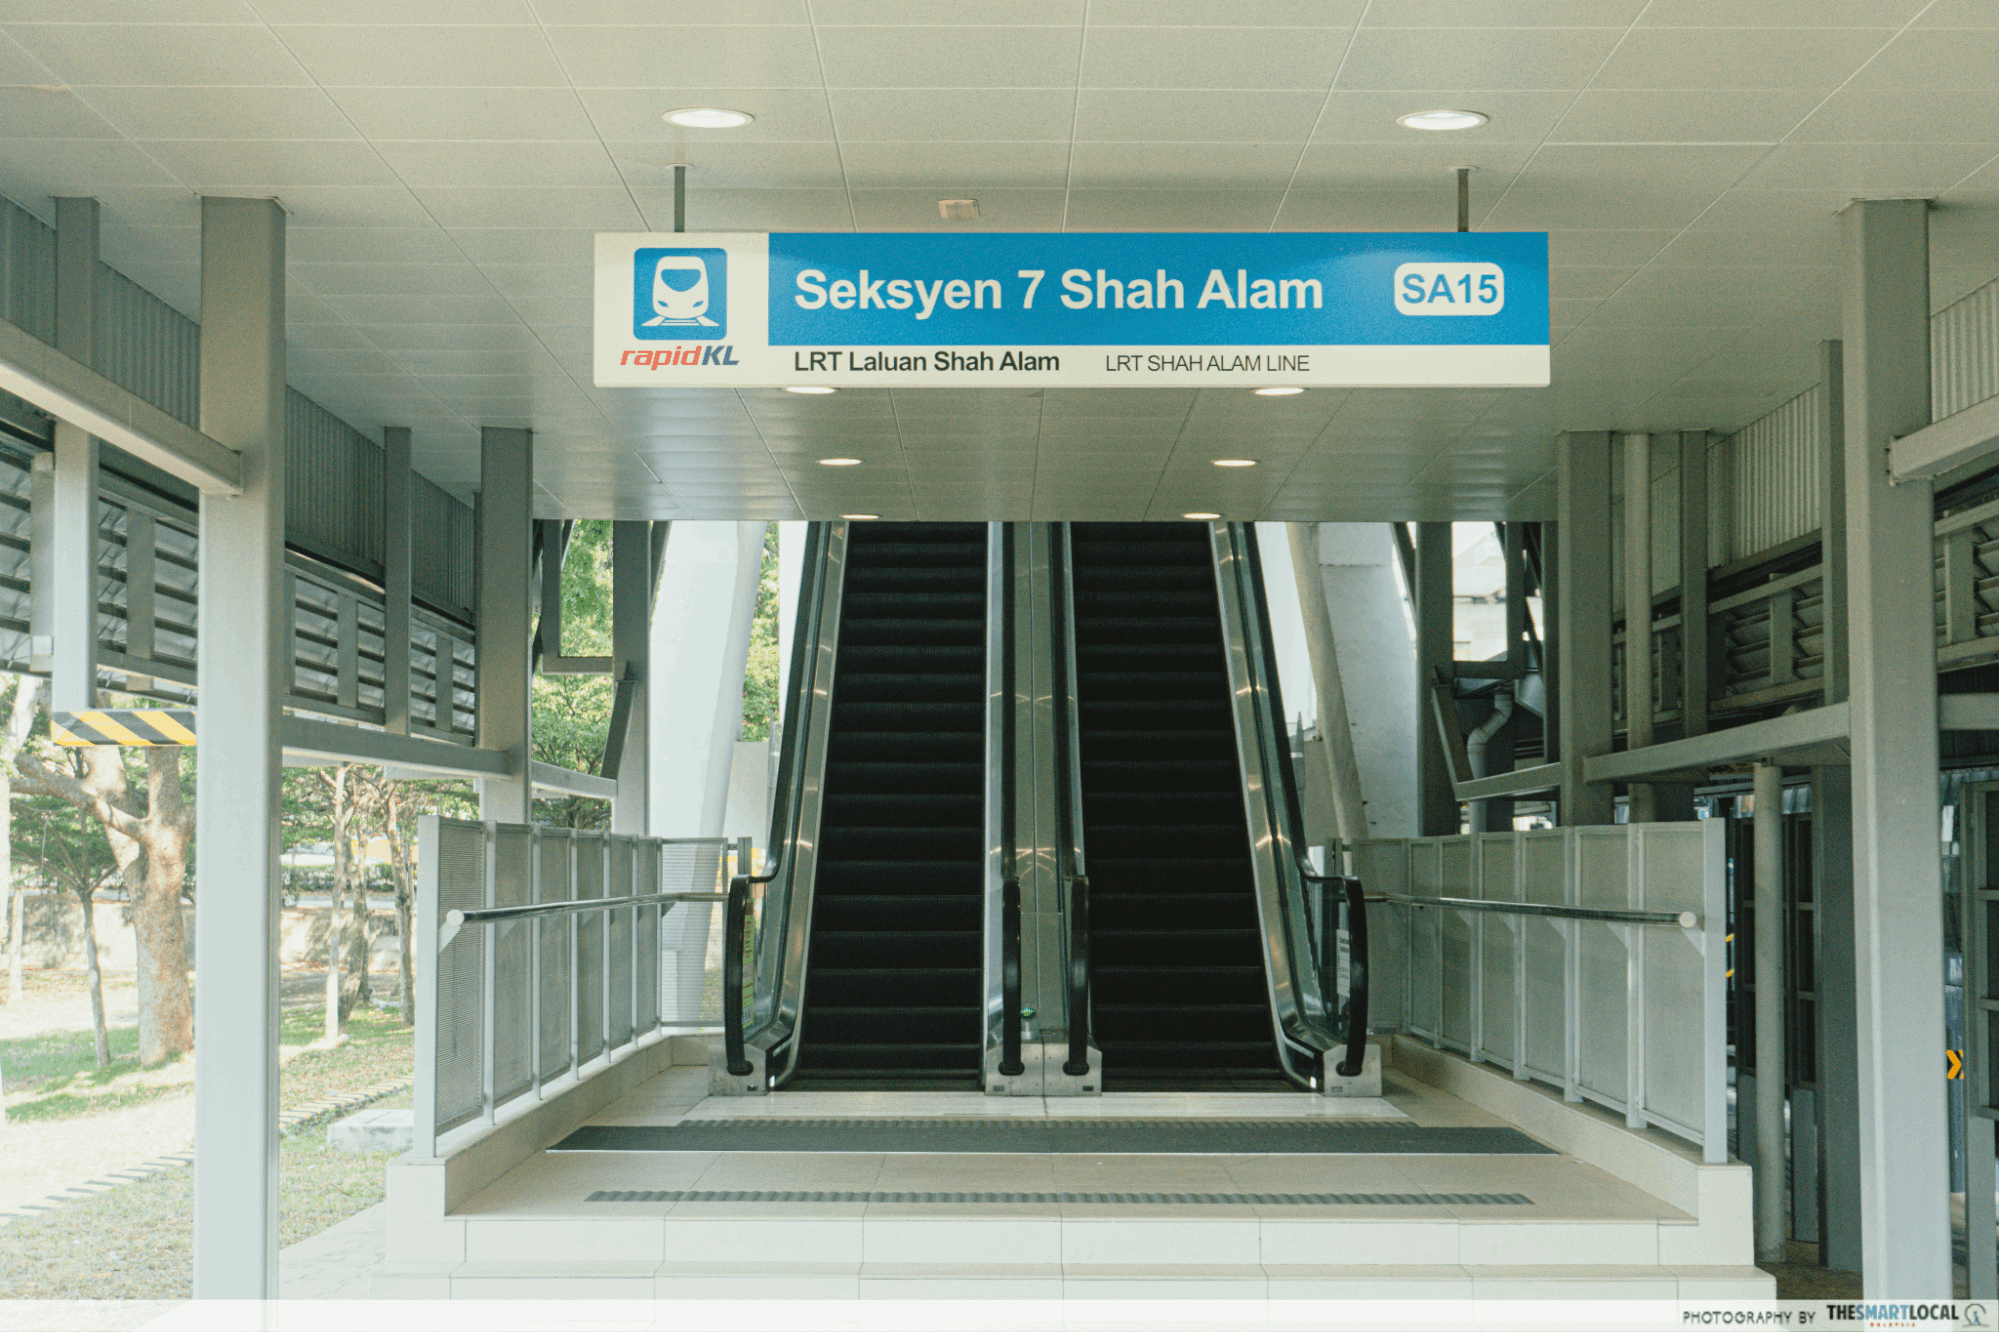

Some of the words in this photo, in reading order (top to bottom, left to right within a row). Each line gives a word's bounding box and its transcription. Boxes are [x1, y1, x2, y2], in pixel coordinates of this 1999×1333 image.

[795, 269, 1002, 320] Seksyen
[1018, 269, 1045, 309] 7
[1060, 268, 1184, 310] Shah
[1197, 269, 1323, 309] Alam
[1402, 273, 1499, 305] SA15
[620, 345, 740, 371] rapidKL
[795, 351, 842, 372] LRT
[849, 351, 927, 372] Laluan
[934, 351, 994, 372] Shah
[999, 351, 1060, 372] Alam
[1106, 355, 1144, 372] LRT
[1147, 355, 1203, 372] SHAH
[1206, 355, 1261, 372] ALAM
[1267, 355, 1310, 372] LINE
